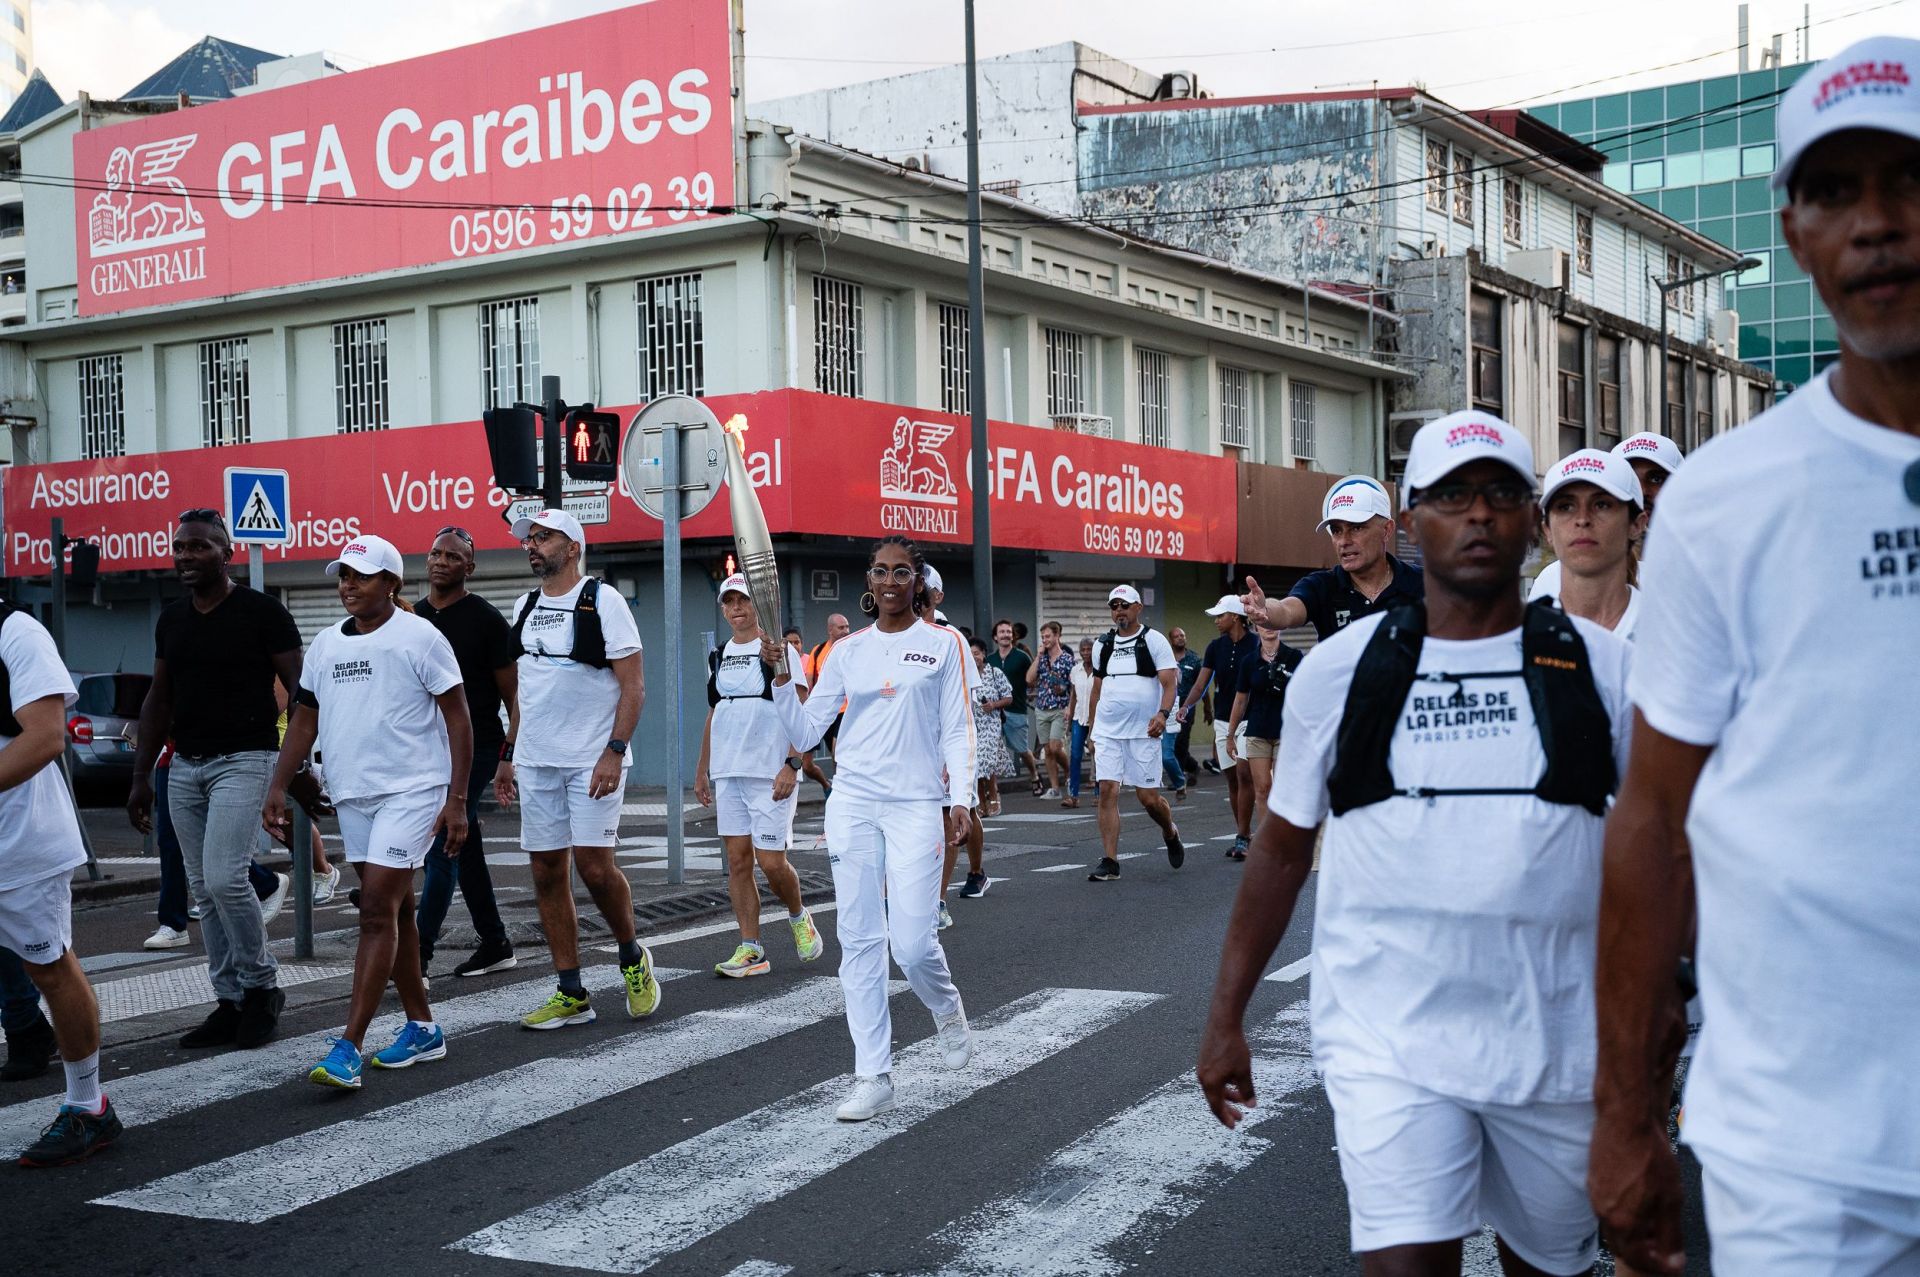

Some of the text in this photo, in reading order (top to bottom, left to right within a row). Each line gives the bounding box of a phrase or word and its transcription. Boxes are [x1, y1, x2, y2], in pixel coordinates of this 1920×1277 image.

[217, 68, 712, 219] GFA Caraïbes
[450, 171, 715, 257] 0596 59 02 39
[90, 246, 207, 296] GENERALI
[30, 470, 170, 509] Assurance
[382, 469, 475, 514] Votre
[1051, 454, 1184, 520] Caraïbes
[562, 500, 606, 511] mmercial
[577, 512, 605, 520] Lumina
[881, 504, 958, 534] GENERALI
[1084, 522, 1184, 556] 0596 59 02 39
[1861, 556, 1898, 579] LA
[332, 668, 373, 679] LA FLAMME
[334, 660, 370, 671] RELAIS DE
[1414, 692, 1508, 712] RELAIS DE
[1406, 707, 1518, 730] LA FLAMME
